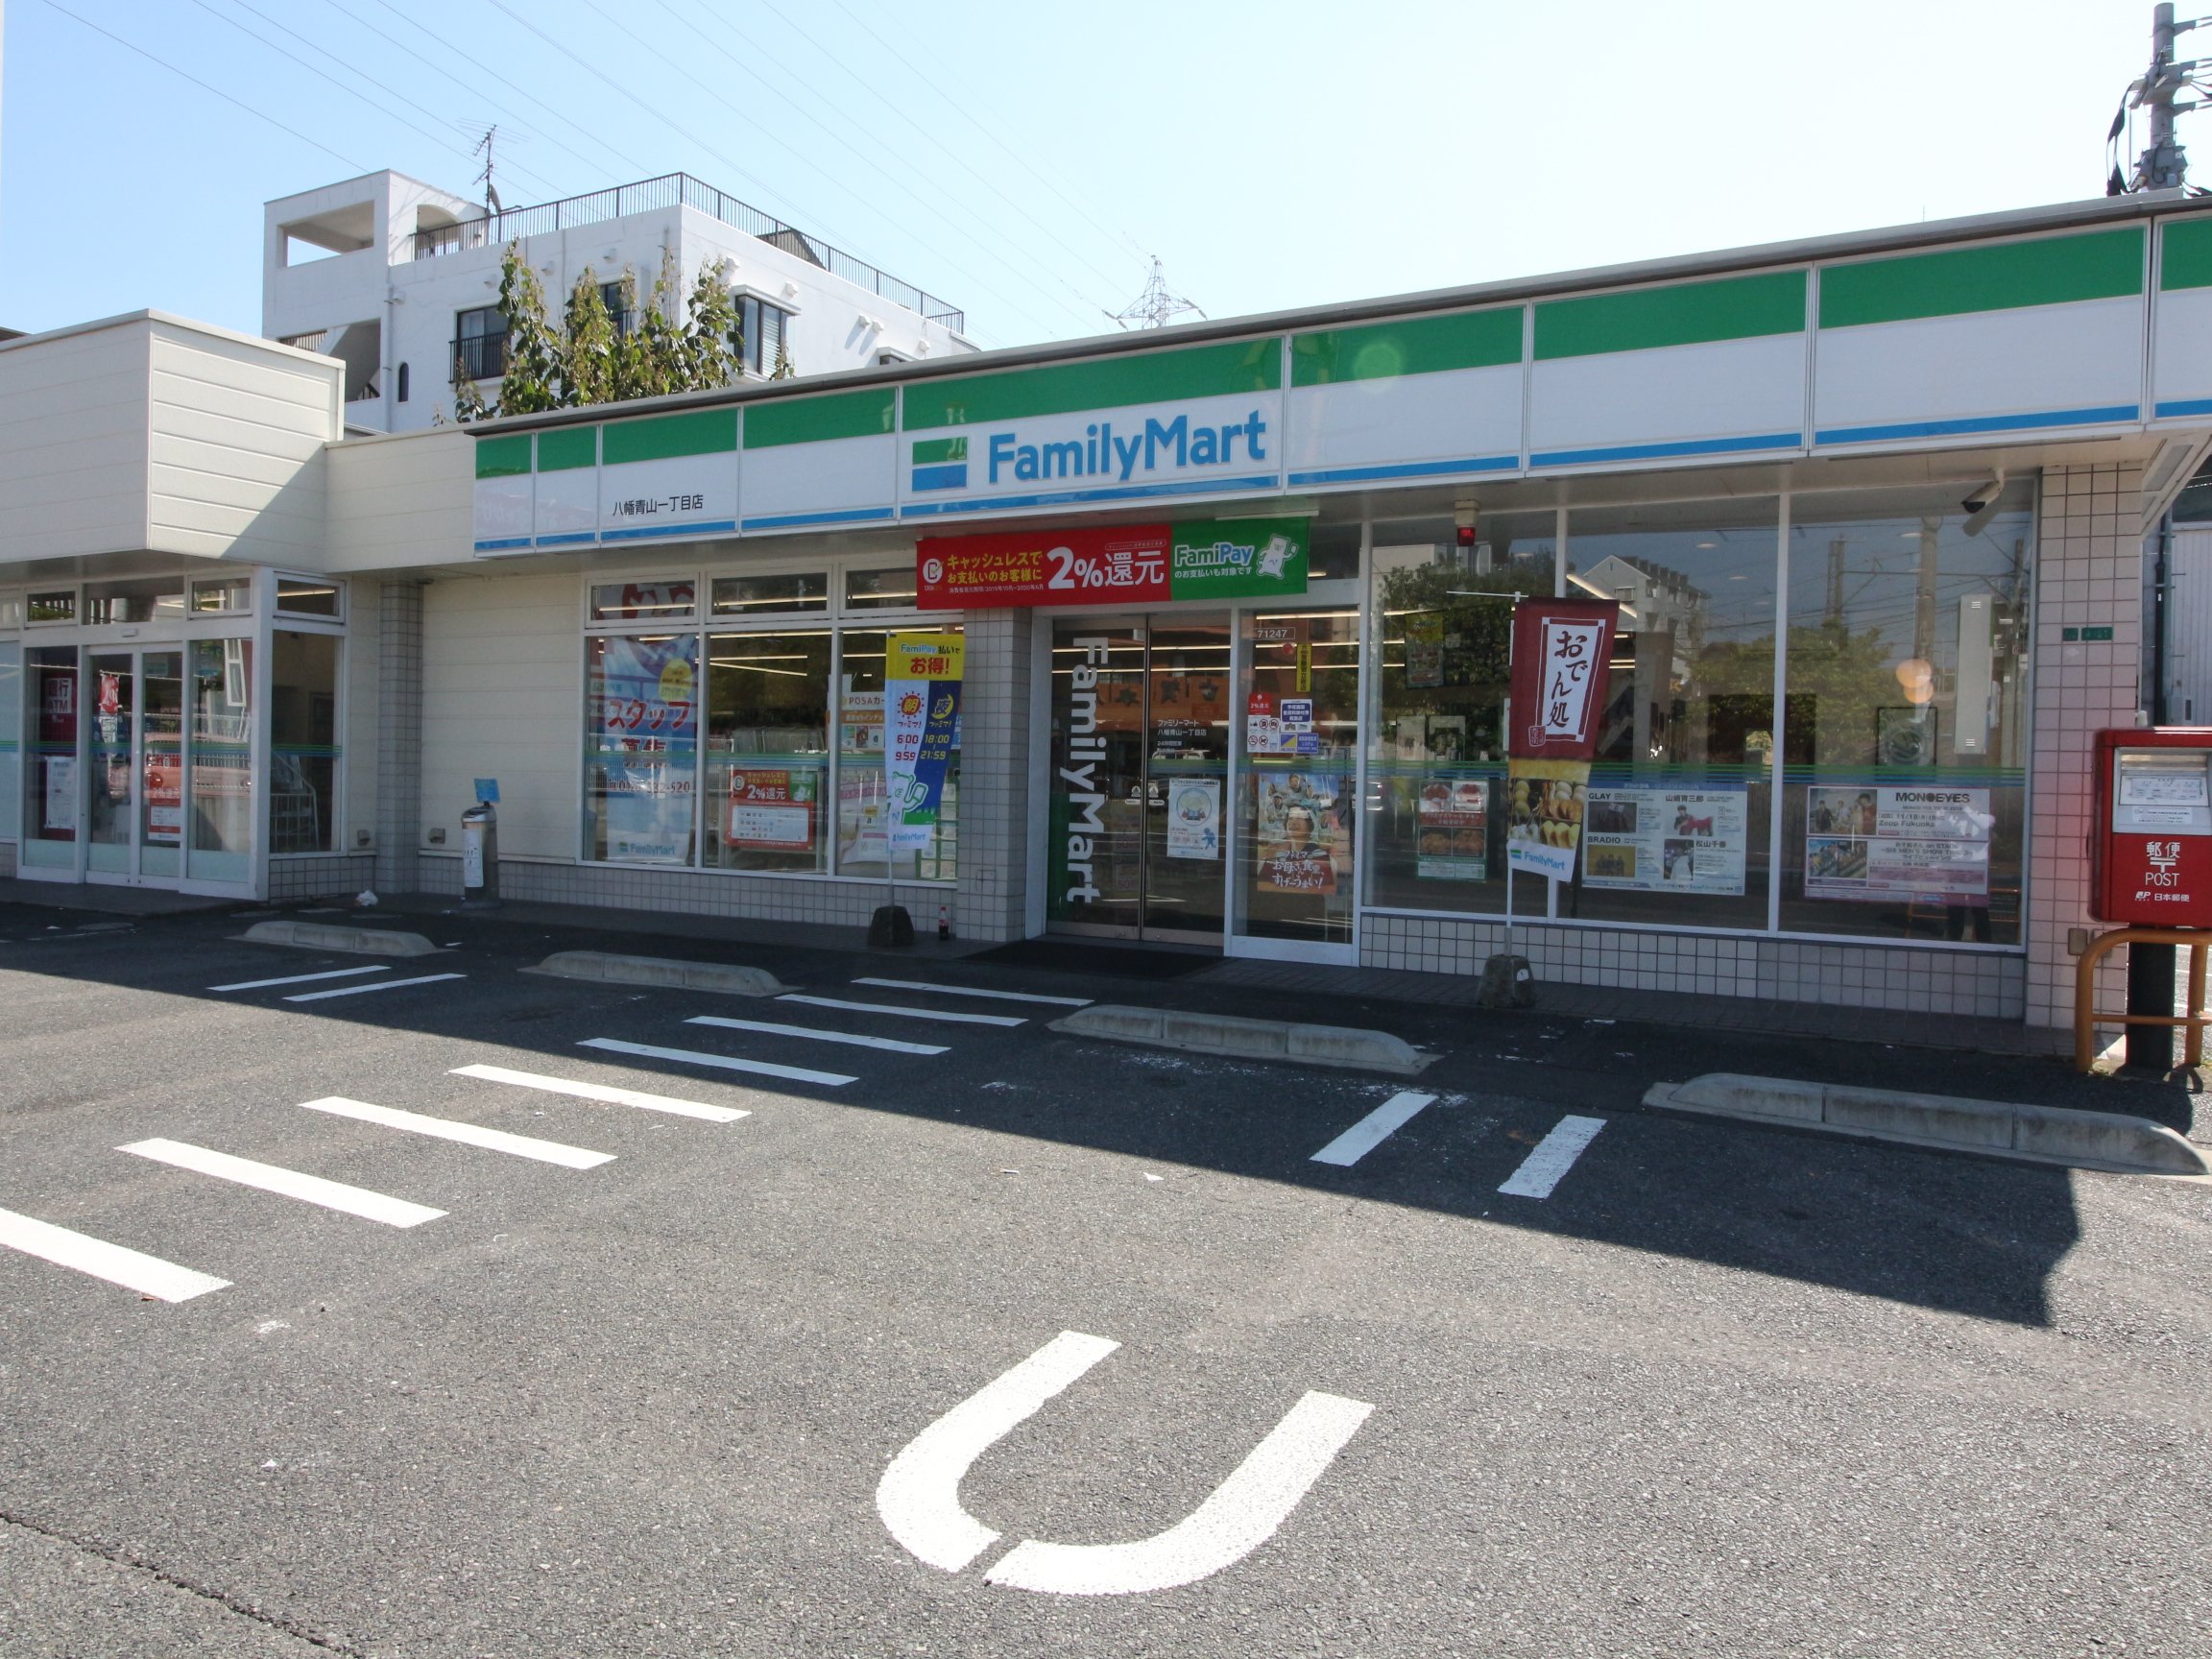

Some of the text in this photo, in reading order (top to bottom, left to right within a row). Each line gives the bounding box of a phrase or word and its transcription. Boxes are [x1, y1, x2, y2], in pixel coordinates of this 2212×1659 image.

[989, 410, 1267, 490] FamilyMart
[612, 493, 704, 517] 八幡青山一丁目店
[947, 550, 1044, 569] キャッシュレスで
[1174, 541, 1255, 568] FamiPay
[1048, 545, 1165, 590] 2%還元
[1174, 565, 1253, 579] のお支払いも対象です
[947, 568, 1043, 584] お支払いのお客様に
[1257, 628, 1288, 638] 71247
[900, 642, 937, 656] FamiPay
[909, 657, 950, 675] お得!
[1546, 630, 1588, 728] おでん処
[46, 699, 68, 713] ATM
[904, 698, 919, 712] 朝
[607, 698, 692, 731] スタッフ
[897, 733, 919, 744] 6:00
[925, 733, 950, 744] 18:00
[895, 751, 916, 761] 9:59
[920, 750, 947, 760] 21:59
[1060, 637, 1109, 904] FamilyMart
[746, 783, 786, 800] 2%還元
[1587, 836, 1621, 845] BRADIO
[631, 842, 676, 856] FamilyMart
[2146, 841, 2181, 858] 郵便
[1525, 851, 1566, 872] FamilyMart
[2145, 872, 2180, 886] POST
[2153, 893, 2190, 902] 日本郵便
